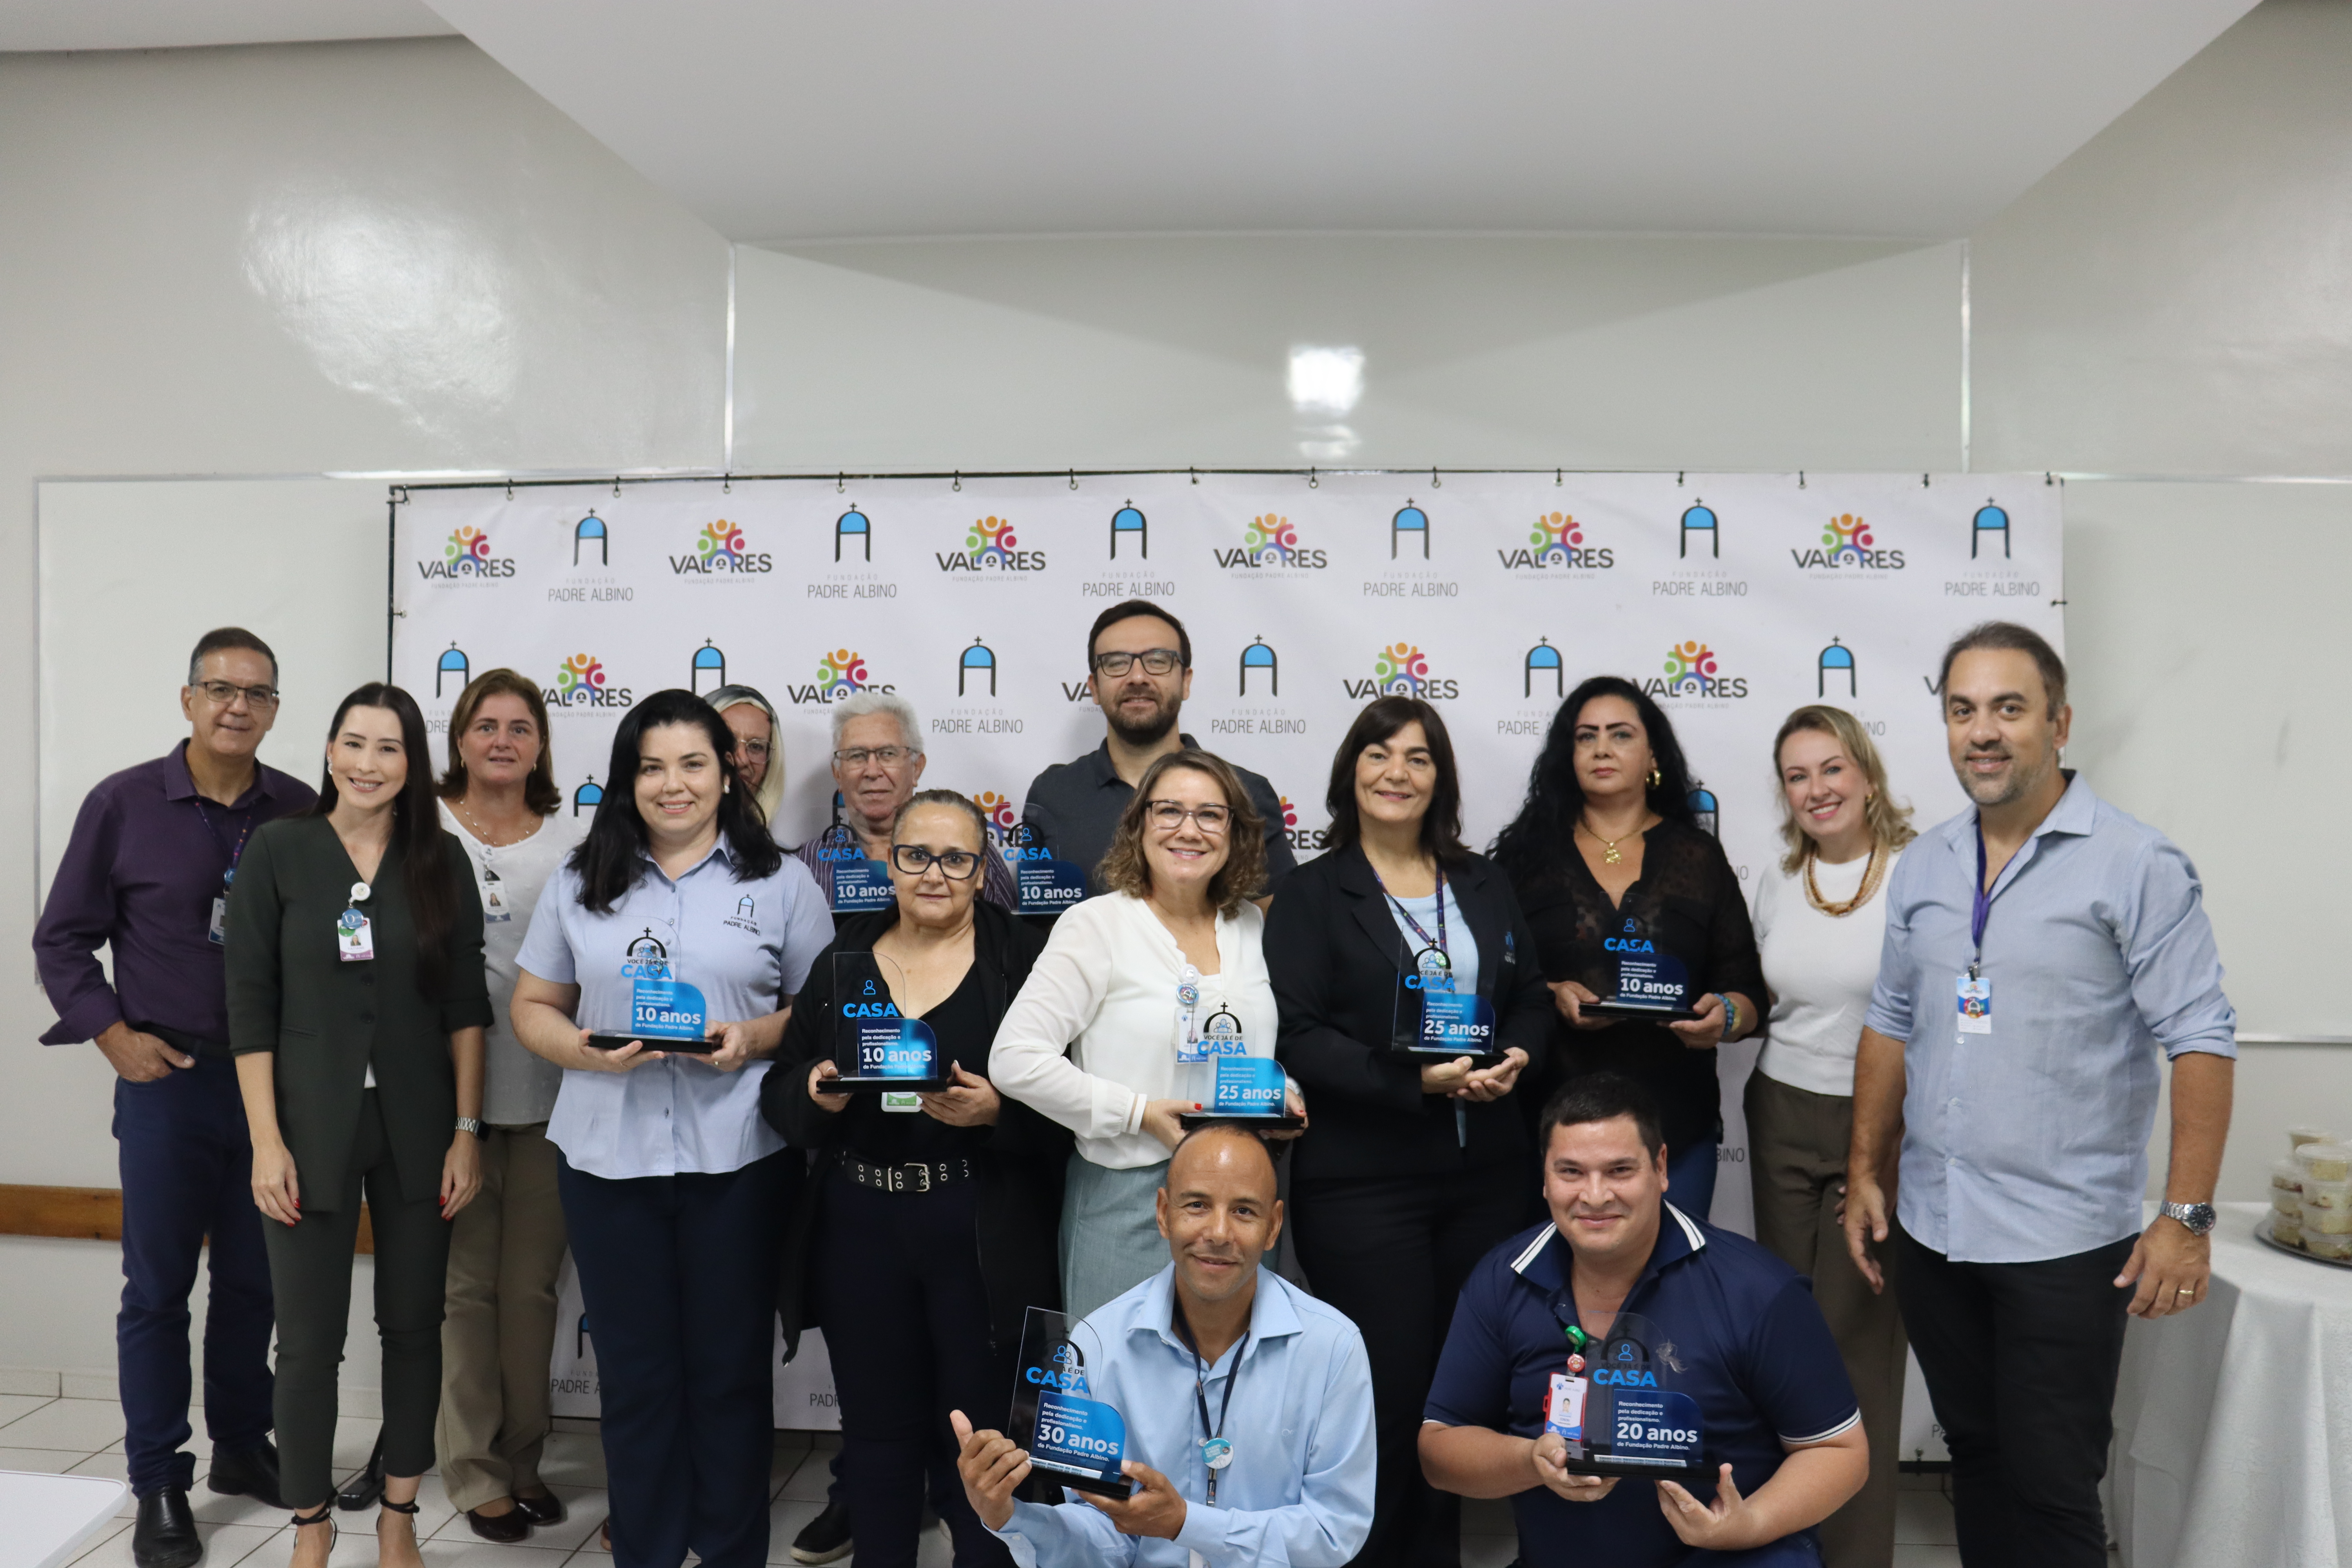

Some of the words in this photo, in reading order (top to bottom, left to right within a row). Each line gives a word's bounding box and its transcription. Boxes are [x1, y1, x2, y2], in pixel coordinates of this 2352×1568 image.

[549, 588, 585, 601] PADRE
[591, 588, 633, 601] ALBINO
[808, 585, 848, 598] PADRE
[854, 584, 896, 598] ALBINO
[1083, 583, 1123, 596] PADRE
[1129, 582, 1174, 596] ALBINO
[1364, 583, 1405, 596] PADRE
[1412, 583, 1458, 596] ALBINO
[1653, 582, 1695, 595] PADRE
[1701, 581, 1747, 596] ALBINO
[1945, 582, 1987, 595] PADRE
[1993, 582, 2040, 596] ALBINO
[426, 720, 448, 733] DRE
[933, 719, 971, 733] PADRE
[978, 719, 1022, 733] ALBINO
[1212, 720, 1253, 733] PADRE
[1259, 720, 1305, 733] ALBINO
[1498, 720, 1539, 735] PADRE
[818, 848, 865, 861] CASA
[1004, 848, 1052, 861] CASA
[837, 885, 856, 898] 10
[859, 886, 896, 897] anos
[1022, 886, 1040, 899] 10
[1044, 888, 1082, 899] anos
[744, 925, 760, 936] ALBINO
[621, 964, 672, 980] CASA
[1405, 975, 1456, 991] CASA
[1621, 978, 1640, 992] 10
[1643, 982, 1683, 995] anos
[636, 1007, 656, 1022] 10
[660, 1011, 701, 1024] anos
[843, 1003, 898, 1018] CASA
[1425, 1020, 1445, 1034] 25
[1448, 1024, 1489, 1036] anos
[863, 1047, 884, 1062] 10
[888, 1050, 932, 1062] anos
[1197, 1041, 1247, 1055] CASA
[1219, 1085, 1238, 1100] 25
[1242, 1088, 1281, 1100] anos
[1717, 1148, 1744, 1162] BINO
[1026, 1367, 1089, 1394] CASA
[1593, 1369, 1657, 1387] CASA
[551, 1379, 590, 1394] PADRE
[1044, 1403, 1087, 1416] Reconhecimento
[1055, 1413, 1082, 1423] dedicação
[1038, 1424, 1065, 1443] 30
[1068, 1434, 1118, 1455] anos
[1617, 1423, 1642, 1439] 20
[1647, 1428, 1697, 1443] anos
[1046, 1445, 1072, 1454] Fundação
